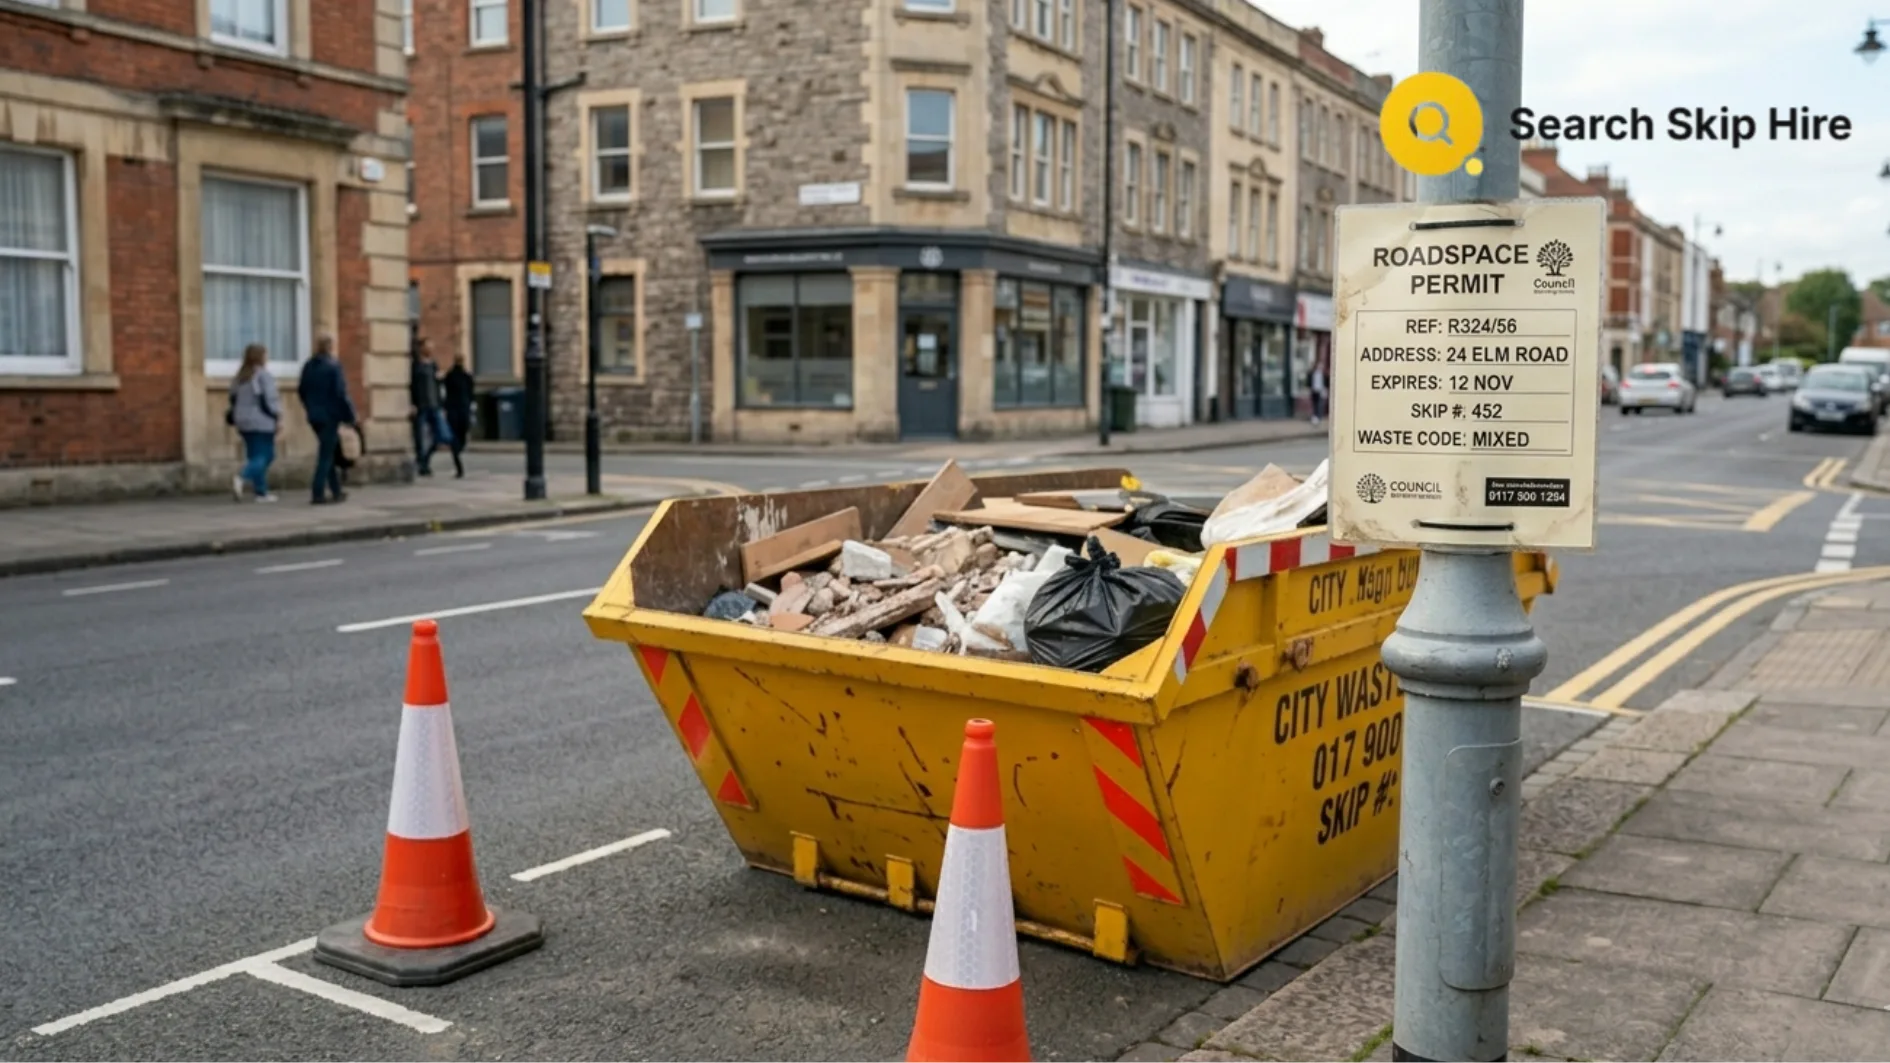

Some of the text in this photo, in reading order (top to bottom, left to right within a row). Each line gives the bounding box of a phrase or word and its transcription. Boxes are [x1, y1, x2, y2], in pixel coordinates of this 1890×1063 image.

[1373, 243, 1529, 268] ROADSPACE
[1411, 273, 1506, 295] PERMIT
[1406, 317, 1517, 334] REF: R324/56
[1359, 346, 1569, 363] ADDRESS: 24 ELM ROAD
[1371, 374, 1514, 391] EXPIRES: 12 NOV
[1410, 403, 1503, 420] SKIP #: 452
[1357, 429, 1531, 448] WASTE CODE: MIXED
[1389, 481, 1442, 493] COUNCIL
[1308, 568, 1347, 615] CITY
[1274, 661, 1404, 745] CITY WAST
[1313, 729, 1356, 791] 017
[1317, 781, 1370, 845] SKIP
